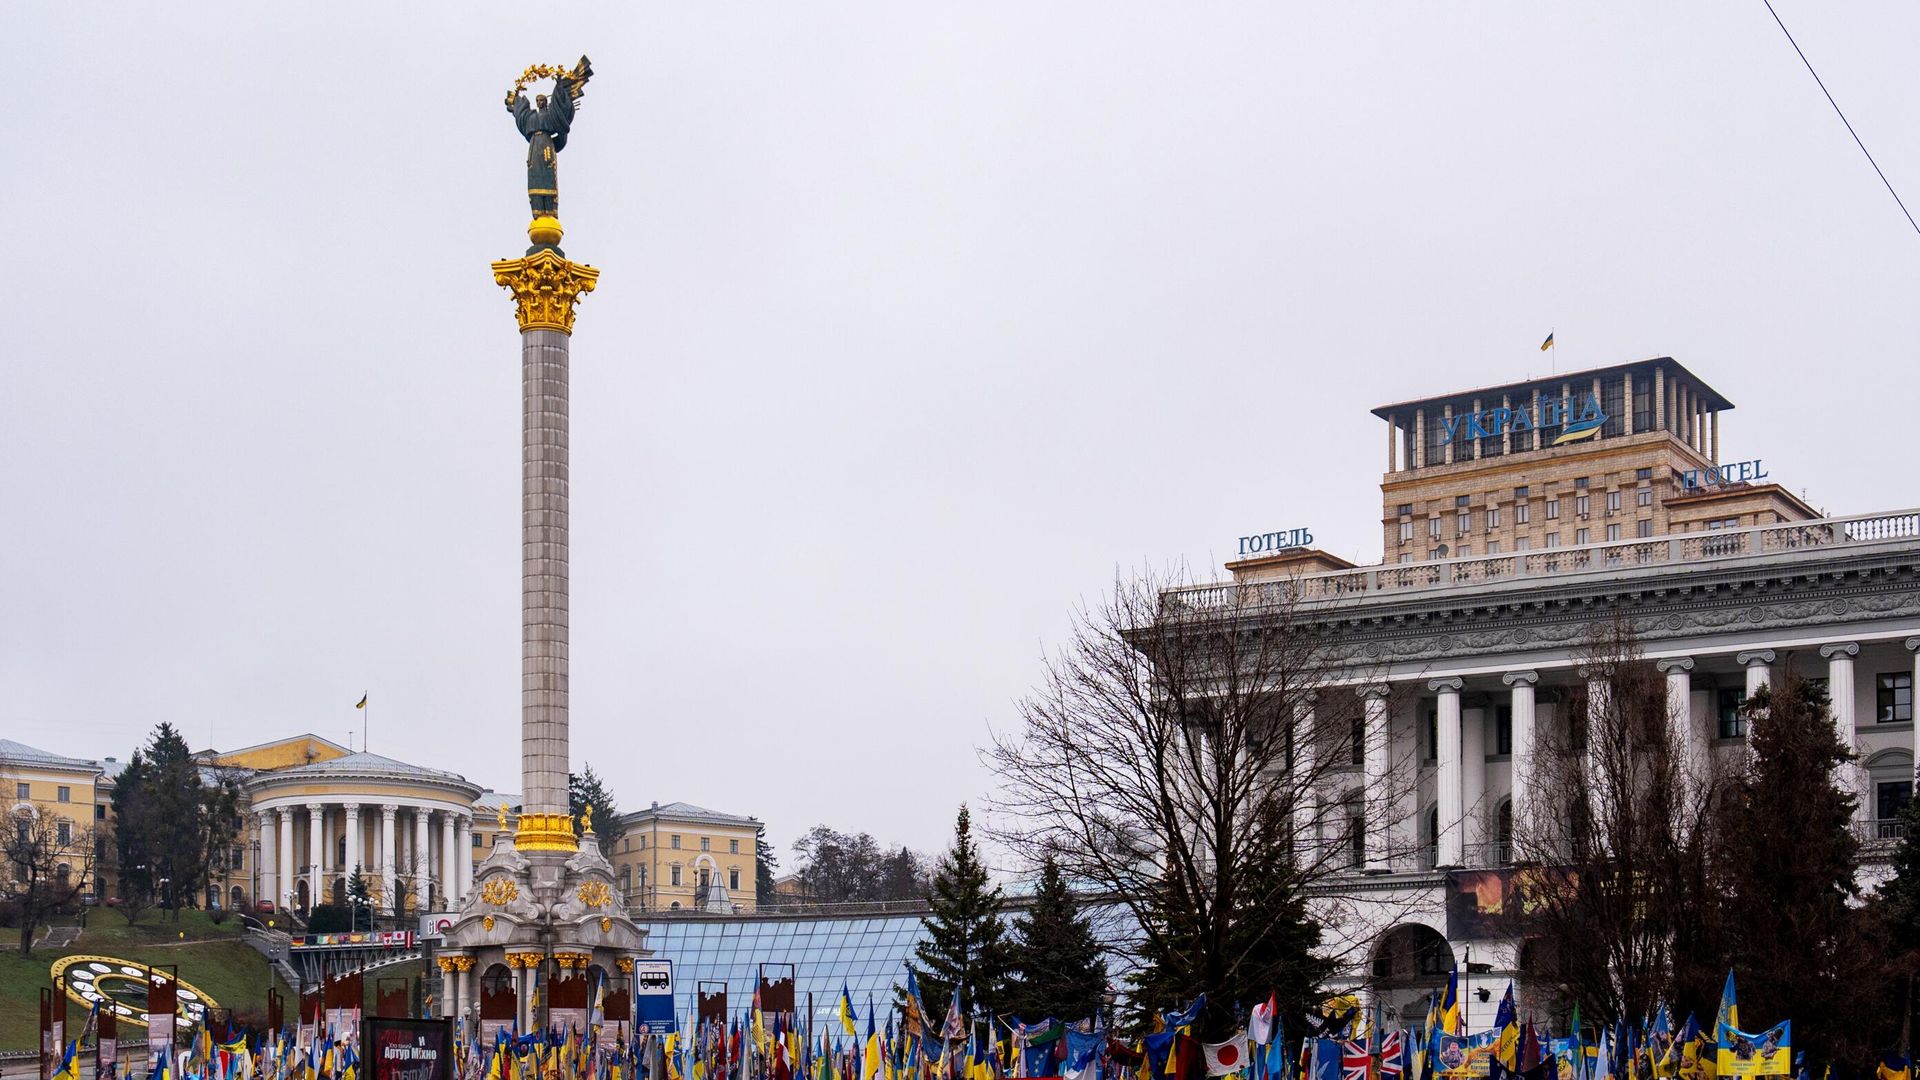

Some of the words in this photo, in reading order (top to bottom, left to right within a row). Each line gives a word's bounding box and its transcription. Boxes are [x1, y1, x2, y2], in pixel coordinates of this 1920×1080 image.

[1440, 392, 1606, 446] УКРАЇНА
[1683, 459, 1769, 489] HOTEL
[1238, 527, 1314, 554] ГОТЕЛЬ
[384, 1047, 410, 1060] Артур
